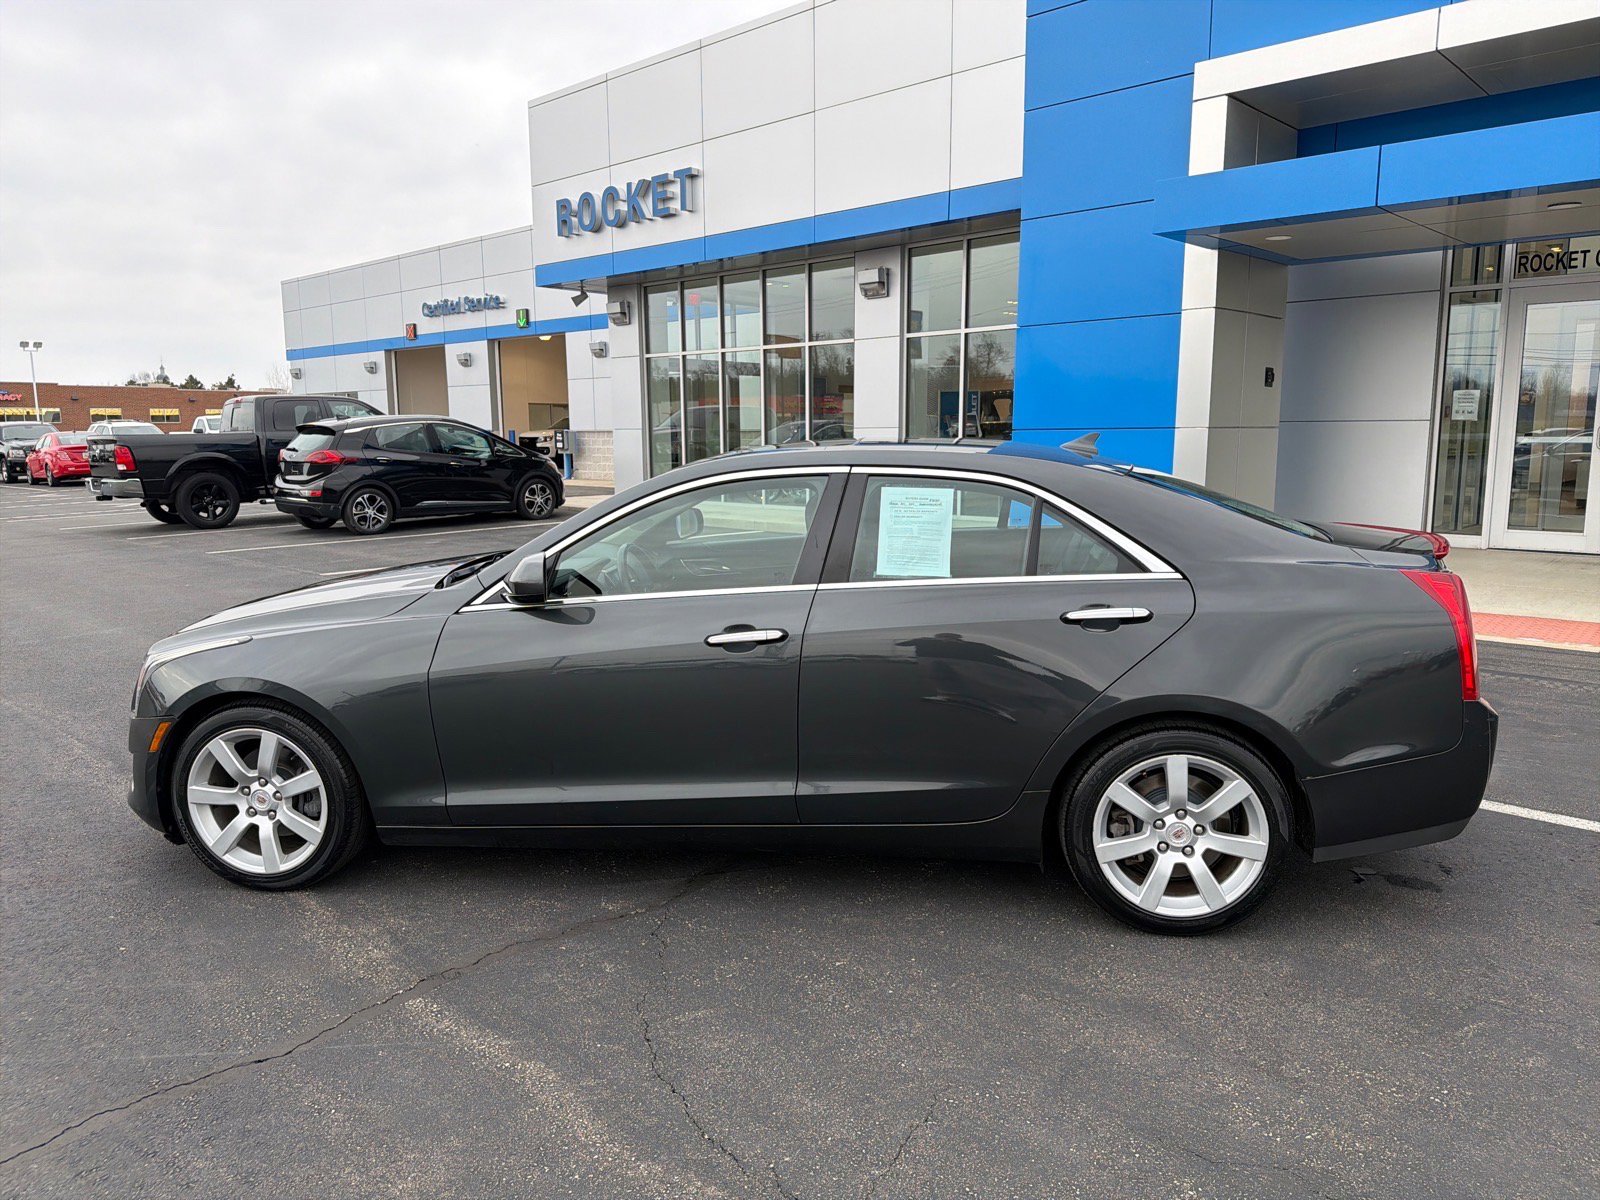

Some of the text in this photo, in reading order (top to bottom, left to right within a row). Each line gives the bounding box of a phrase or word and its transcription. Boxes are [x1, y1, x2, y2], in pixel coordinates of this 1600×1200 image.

[556, 167, 699, 236] ROCKET
[1518, 250, 1590, 273] ROCKET
[422, 293, 503, 317] Certified Service
